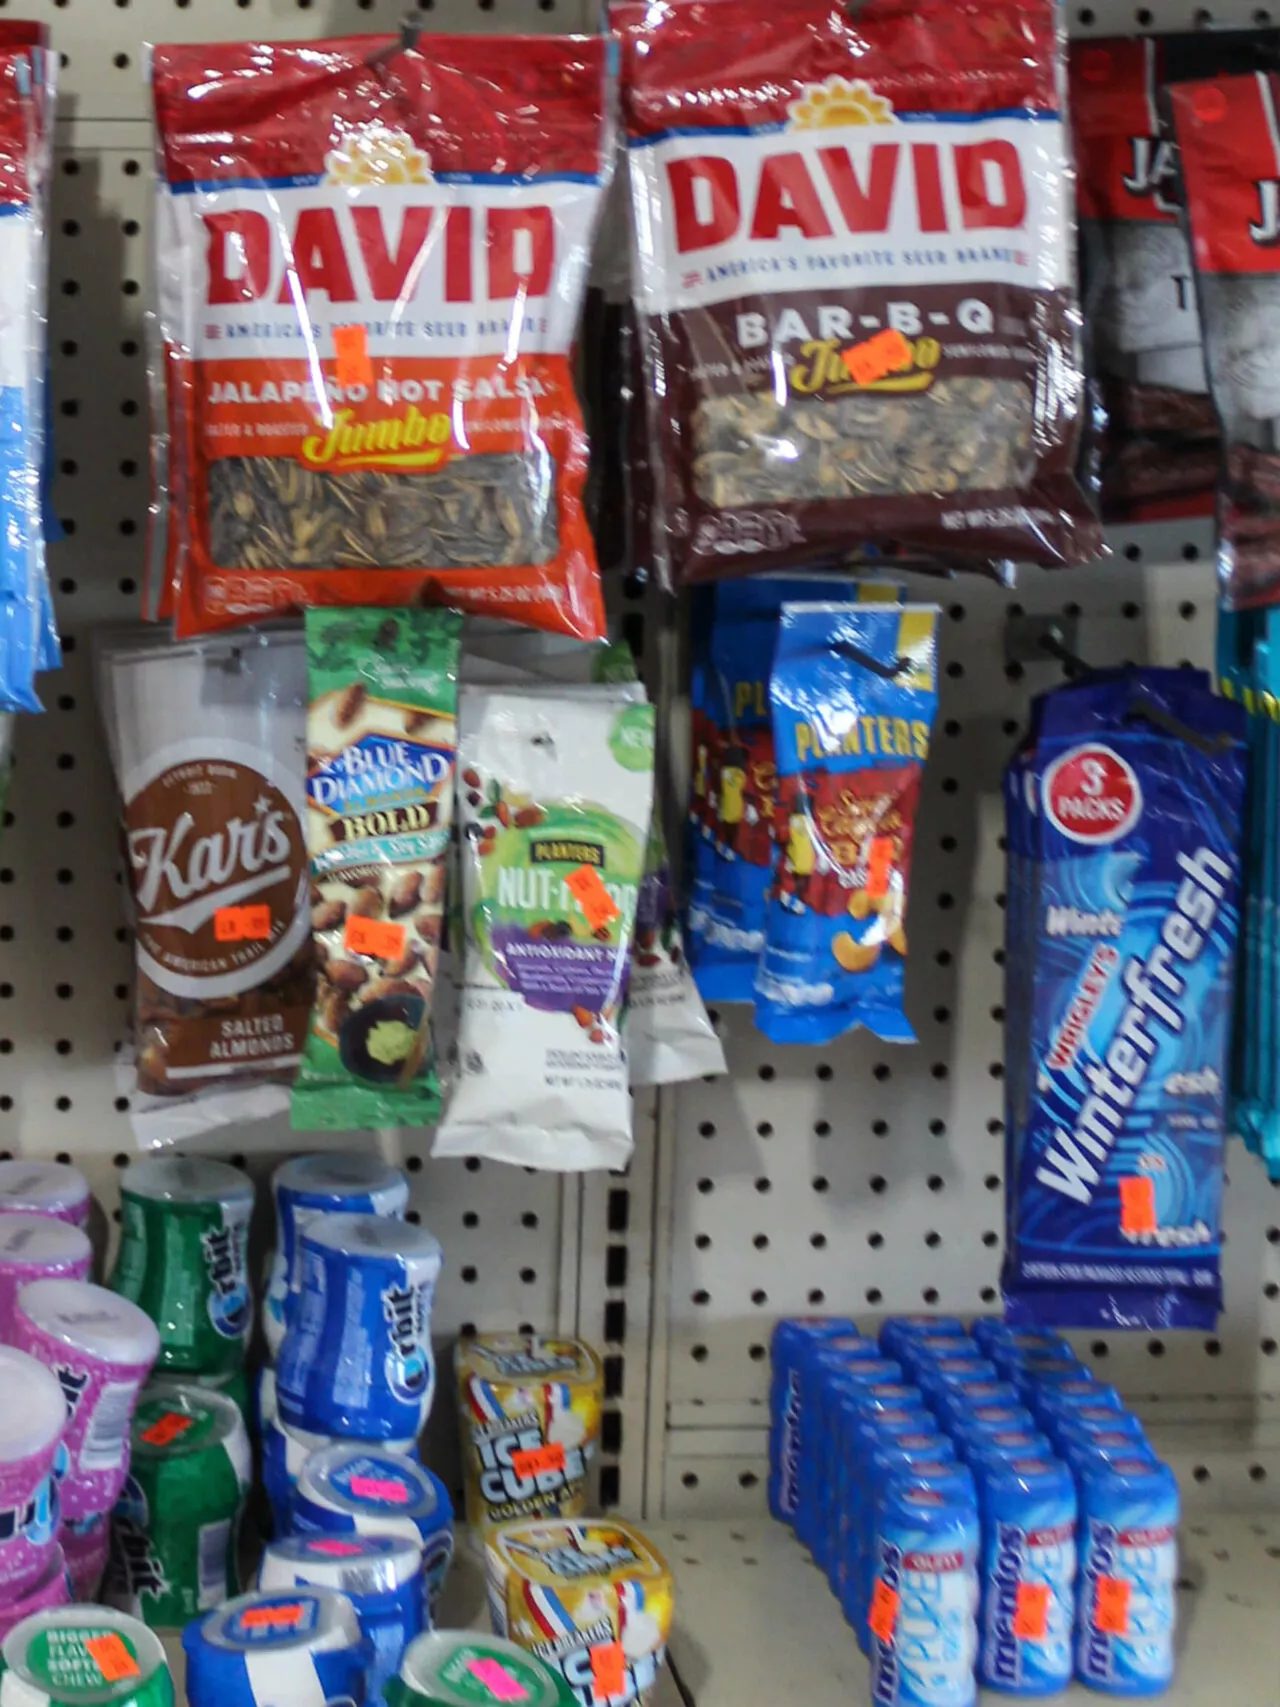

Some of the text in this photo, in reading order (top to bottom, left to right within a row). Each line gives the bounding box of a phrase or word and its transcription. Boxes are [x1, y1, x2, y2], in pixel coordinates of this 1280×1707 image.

[665, 138, 1029, 254] DAVID
[202, 205, 555, 305] DAVID
[476, 319, 538, 336] BRAD
[735, 298, 994, 349] BAR-B-Q
[789, 335, 942, 392] Juo
[378, 379, 443, 405] HOT
[452, 375, 549, 402] SALSA
[302, 406, 452, 464] Jumbo
[342, 740, 410, 777] BLUE
[795, 714, 933, 764] PLNTERS
[312, 752, 450, 806] DIAMOND
[341, 803, 431, 842] BOLD
[1057, 795, 1126, 822] PACKS
[535, 843, 599, 863] PLANTERS
[209, 1032, 295, 1060] ALMONDS
[220, 1012, 285, 1037] SALTED
[1035, 846, 1234, 1206] Winterfresh
[993, 1520, 1027, 1684] mentos
